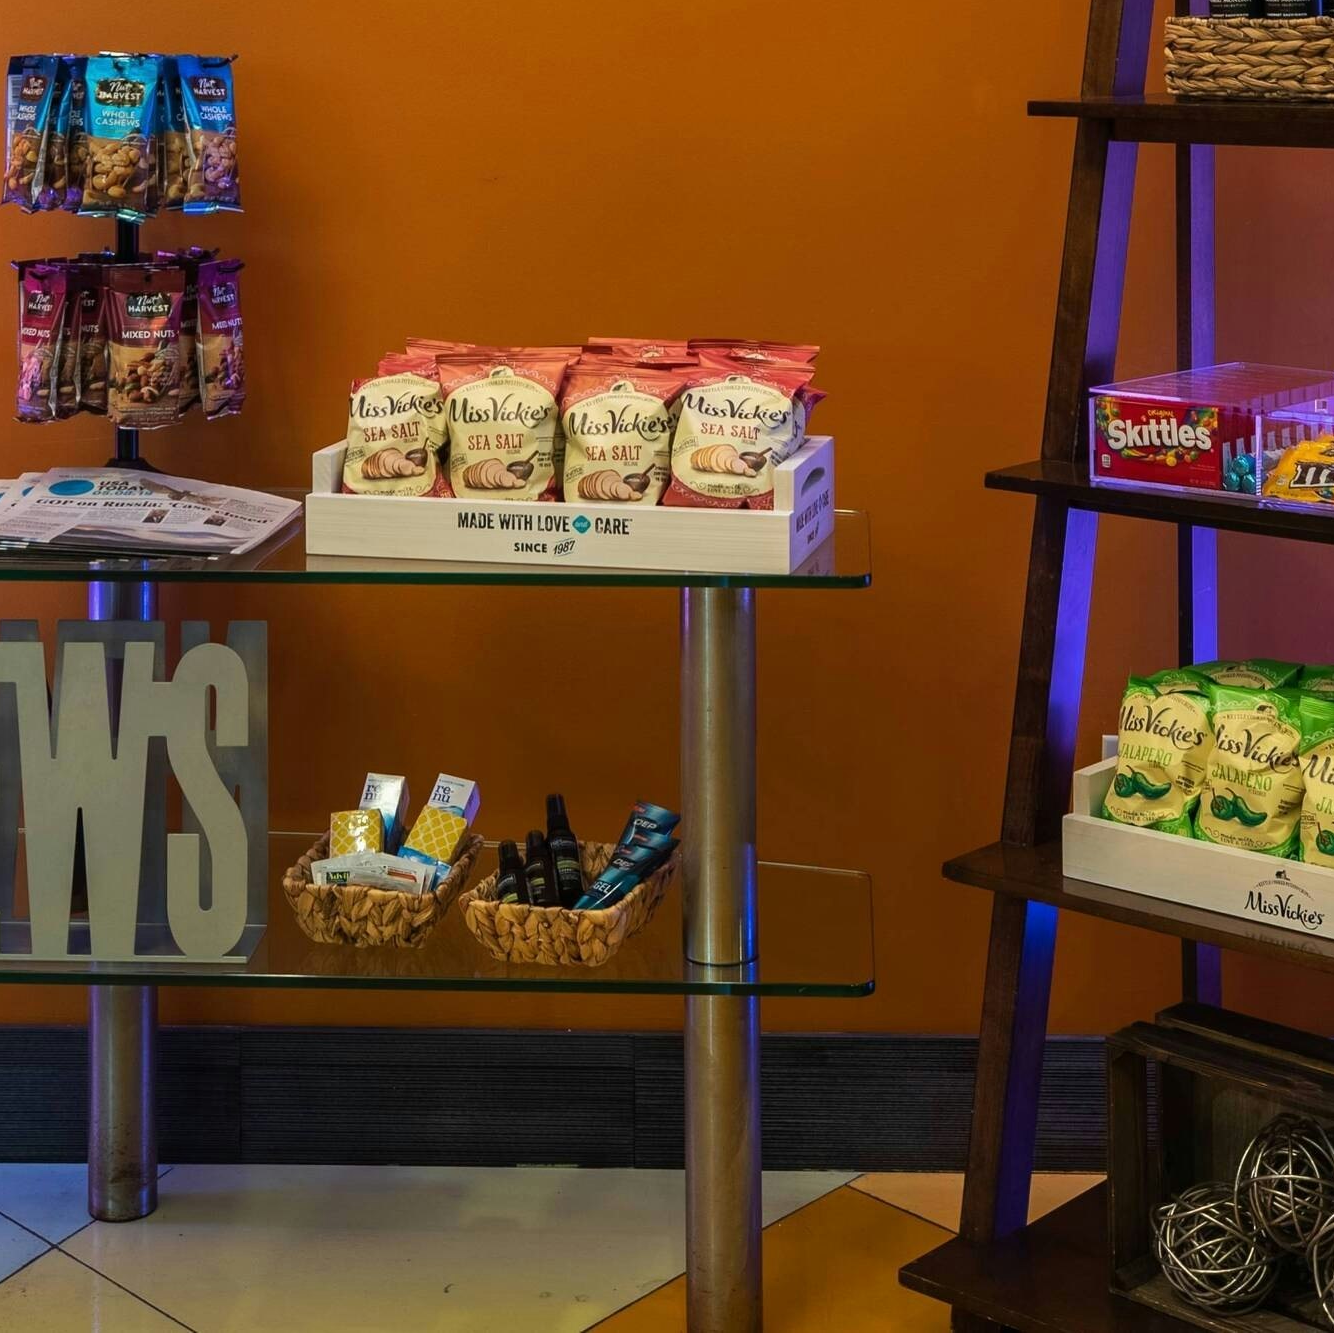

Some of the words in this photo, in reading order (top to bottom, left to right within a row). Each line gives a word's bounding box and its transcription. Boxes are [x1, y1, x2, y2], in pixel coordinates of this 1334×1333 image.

[109, 80, 132, 92] Nut
[199, 78, 215, 89] Nut
[98, 91, 142, 101] HARVEST
[193, 88, 226, 97] HARVEST
[102, 109, 136, 119] WHOLE
[200, 105, 228, 114] WHOLE
[200, 112, 233, 122] CASHEWS
[95, 117, 140, 128] CASHEWS
[136, 295, 156, 306] Nut
[128, 304, 170, 313] HARVEST
[122, 329, 151, 339] MIXED
[153, 329, 175, 339] NUTS
[387, 391, 444, 418] Vickie's
[449, 397, 492, 424] Miss
[489, 393, 550, 428] Vickie's
[682, 393, 727, 418] Miss
[724, 397, 792, 429] Vickie's
[568, 412, 608, 436] Miss
[607, 404, 667, 441] Vickie's
[363, 427, 389, 442] SEA
[391, 421, 421, 439] SALT
[700, 422, 725, 435] SEA
[730, 424, 761, 441] SALT
[1107, 418, 1212, 450] Skittles
[467, 435, 491, 451] SEA
[495, 433, 524, 449] SALT
[585, 446, 607, 461] SEA
[611, 445, 642, 461] SALT
[35, 498, 74, 506] GOP
[103, 500, 162, 508] Russia:
[457, 512, 495, 530] MADE
[498, 513, 533, 531] WITH
[536, 514, 571, 533] LOVE
[595, 518, 630, 535] CARE
[513, 541, 548, 554] SINCE
[552, 539, 576, 556] 1987
[1144, 705, 1207, 750] Vickie's
[1117, 742, 1172, 767] JALAPEÑO
[1243, 728, 1300, 774] Vickie's
[1211, 764, 1273, 791] JALAPEÑO
[432, 793, 451, 803] nu
[633, 817, 657, 830] DEP
[329, 871, 350, 880] Advil
[592, 880, 611, 895] GEL
[1244, 891, 1279, 916] Miss
[1275, 894, 1324, 930] Vickie's
